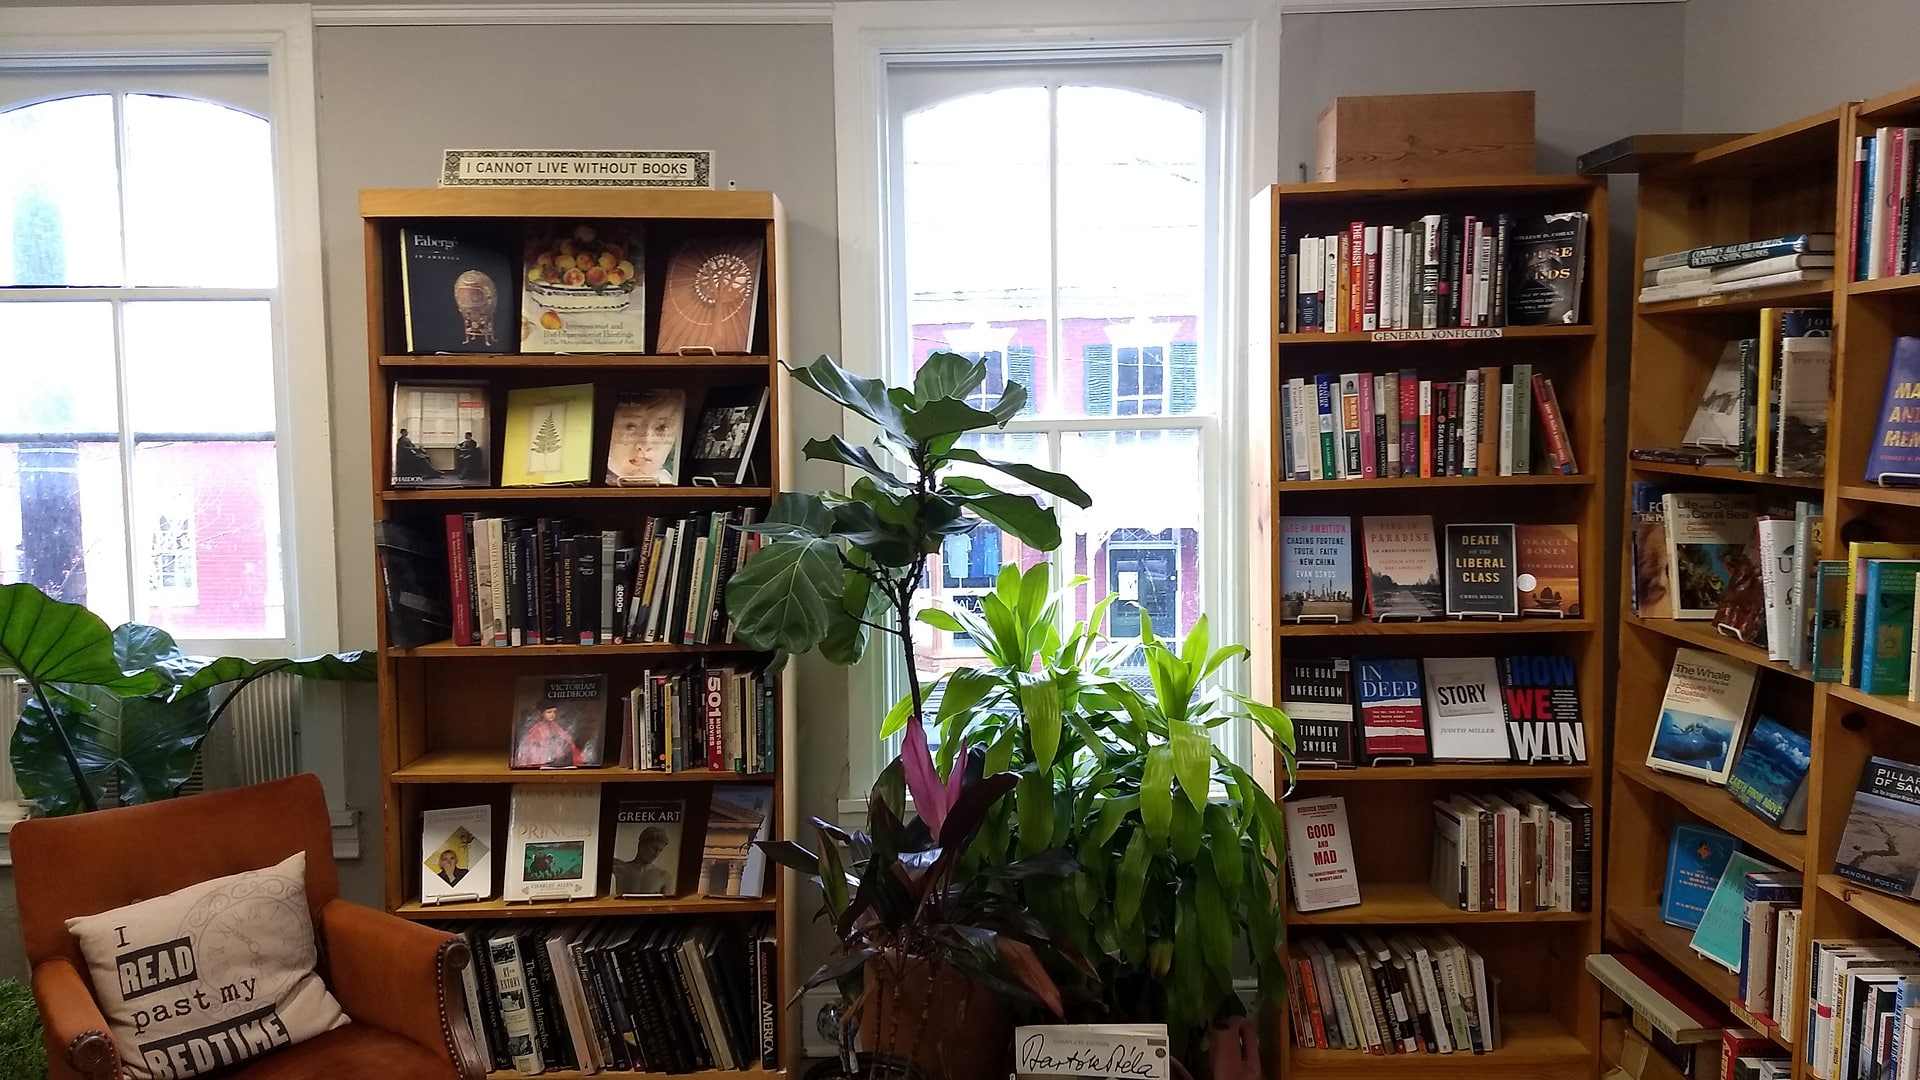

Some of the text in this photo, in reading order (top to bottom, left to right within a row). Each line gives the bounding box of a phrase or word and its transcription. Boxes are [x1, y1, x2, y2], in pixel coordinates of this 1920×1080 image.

[476, 162, 532, 173] CANNOT
[538, 163, 568, 174] LIVE
[574, 163, 637, 174] WITHOUT
[642, 163, 687, 175] BOOKS
[1353, 224, 1362, 266] THE FINISH
[1373, 328, 1500, 341] GENERAL NONFICTION
[1437, 424, 1445, 466] SEABISCUIT
[1677, 500, 1698, 509] Life
[1692, 509, 1723, 518] Coral
[643, 522, 654, 542] Natural
[1286, 524, 1346, 533] AGE AMBITION
[1287, 537, 1344, 545] CHASING FORTUNE
[1371, 533, 1429, 542] PARADISE
[1462, 535, 1499, 545] DEATH
[1523, 538, 1569, 546] ORACLE
[1527, 547, 1567, 555] BONES
[1299, 558, 1335, 566] NEW CHINA
[1455, 558, 1507, 568] LIBERAL
[634, 565, 645, 596] GARDENS
[1296, 570, 1312, 578] EVAN
[1462, 572, 1500, 583] CLASS
[1295, 667, 1337, 679] THE ROAD
[1361, 665, 1382, 681] IN
[1512, 656, 1576, 686] HOW
[1676, 663, 1731, 681] The Whale
[548, 690, 597, 699] CHILDHOOD
[550, 682, 596, 692] VICTORIAN
[1290, 685, 1343, 697] UNFREEDOM
[1362, 681, 1418, 697] DEEP
[1438, 684, 1487, 705] STORY
[707, 677, 721, 717] 501
[1506, 689, 1553, 720] WE
[1299, 724, 1339, 737] TIMOTHY
[1302, 740, 1337, 753] SNYDER
[1509, 721, 1586, 761] WIN
[1875, 776, 1893, 787] OF
[1729, 774, 1749, 793] EARTH
[1761, 797, 1782, 816] ABOVE
[618, 811, 680, 821] GREEK ART
[517, 823, 592, 840] PRINCES
[1307, 823, 1335, 840] GOOD
[1318, 841, 1328, 849] AND
[1314, 850, 1337, 866] MAD
[1840, 868, 1904, 891] SANDRA POSTEL
[114, 925, 130, 948] I
[118, 945, 195, 995] READ
[1446, 964, 1457, 1000] Damages
[131, 977, 256, 1036] past my
[525, 960, 549, 1049] The Golden Horseshoe
[762, 1000, 774, 1055] AMERICA
[1891, 988, 1903, 1061] NO MAN'S LANDS
[143, 1011, 290, 1080] BEDTIME
